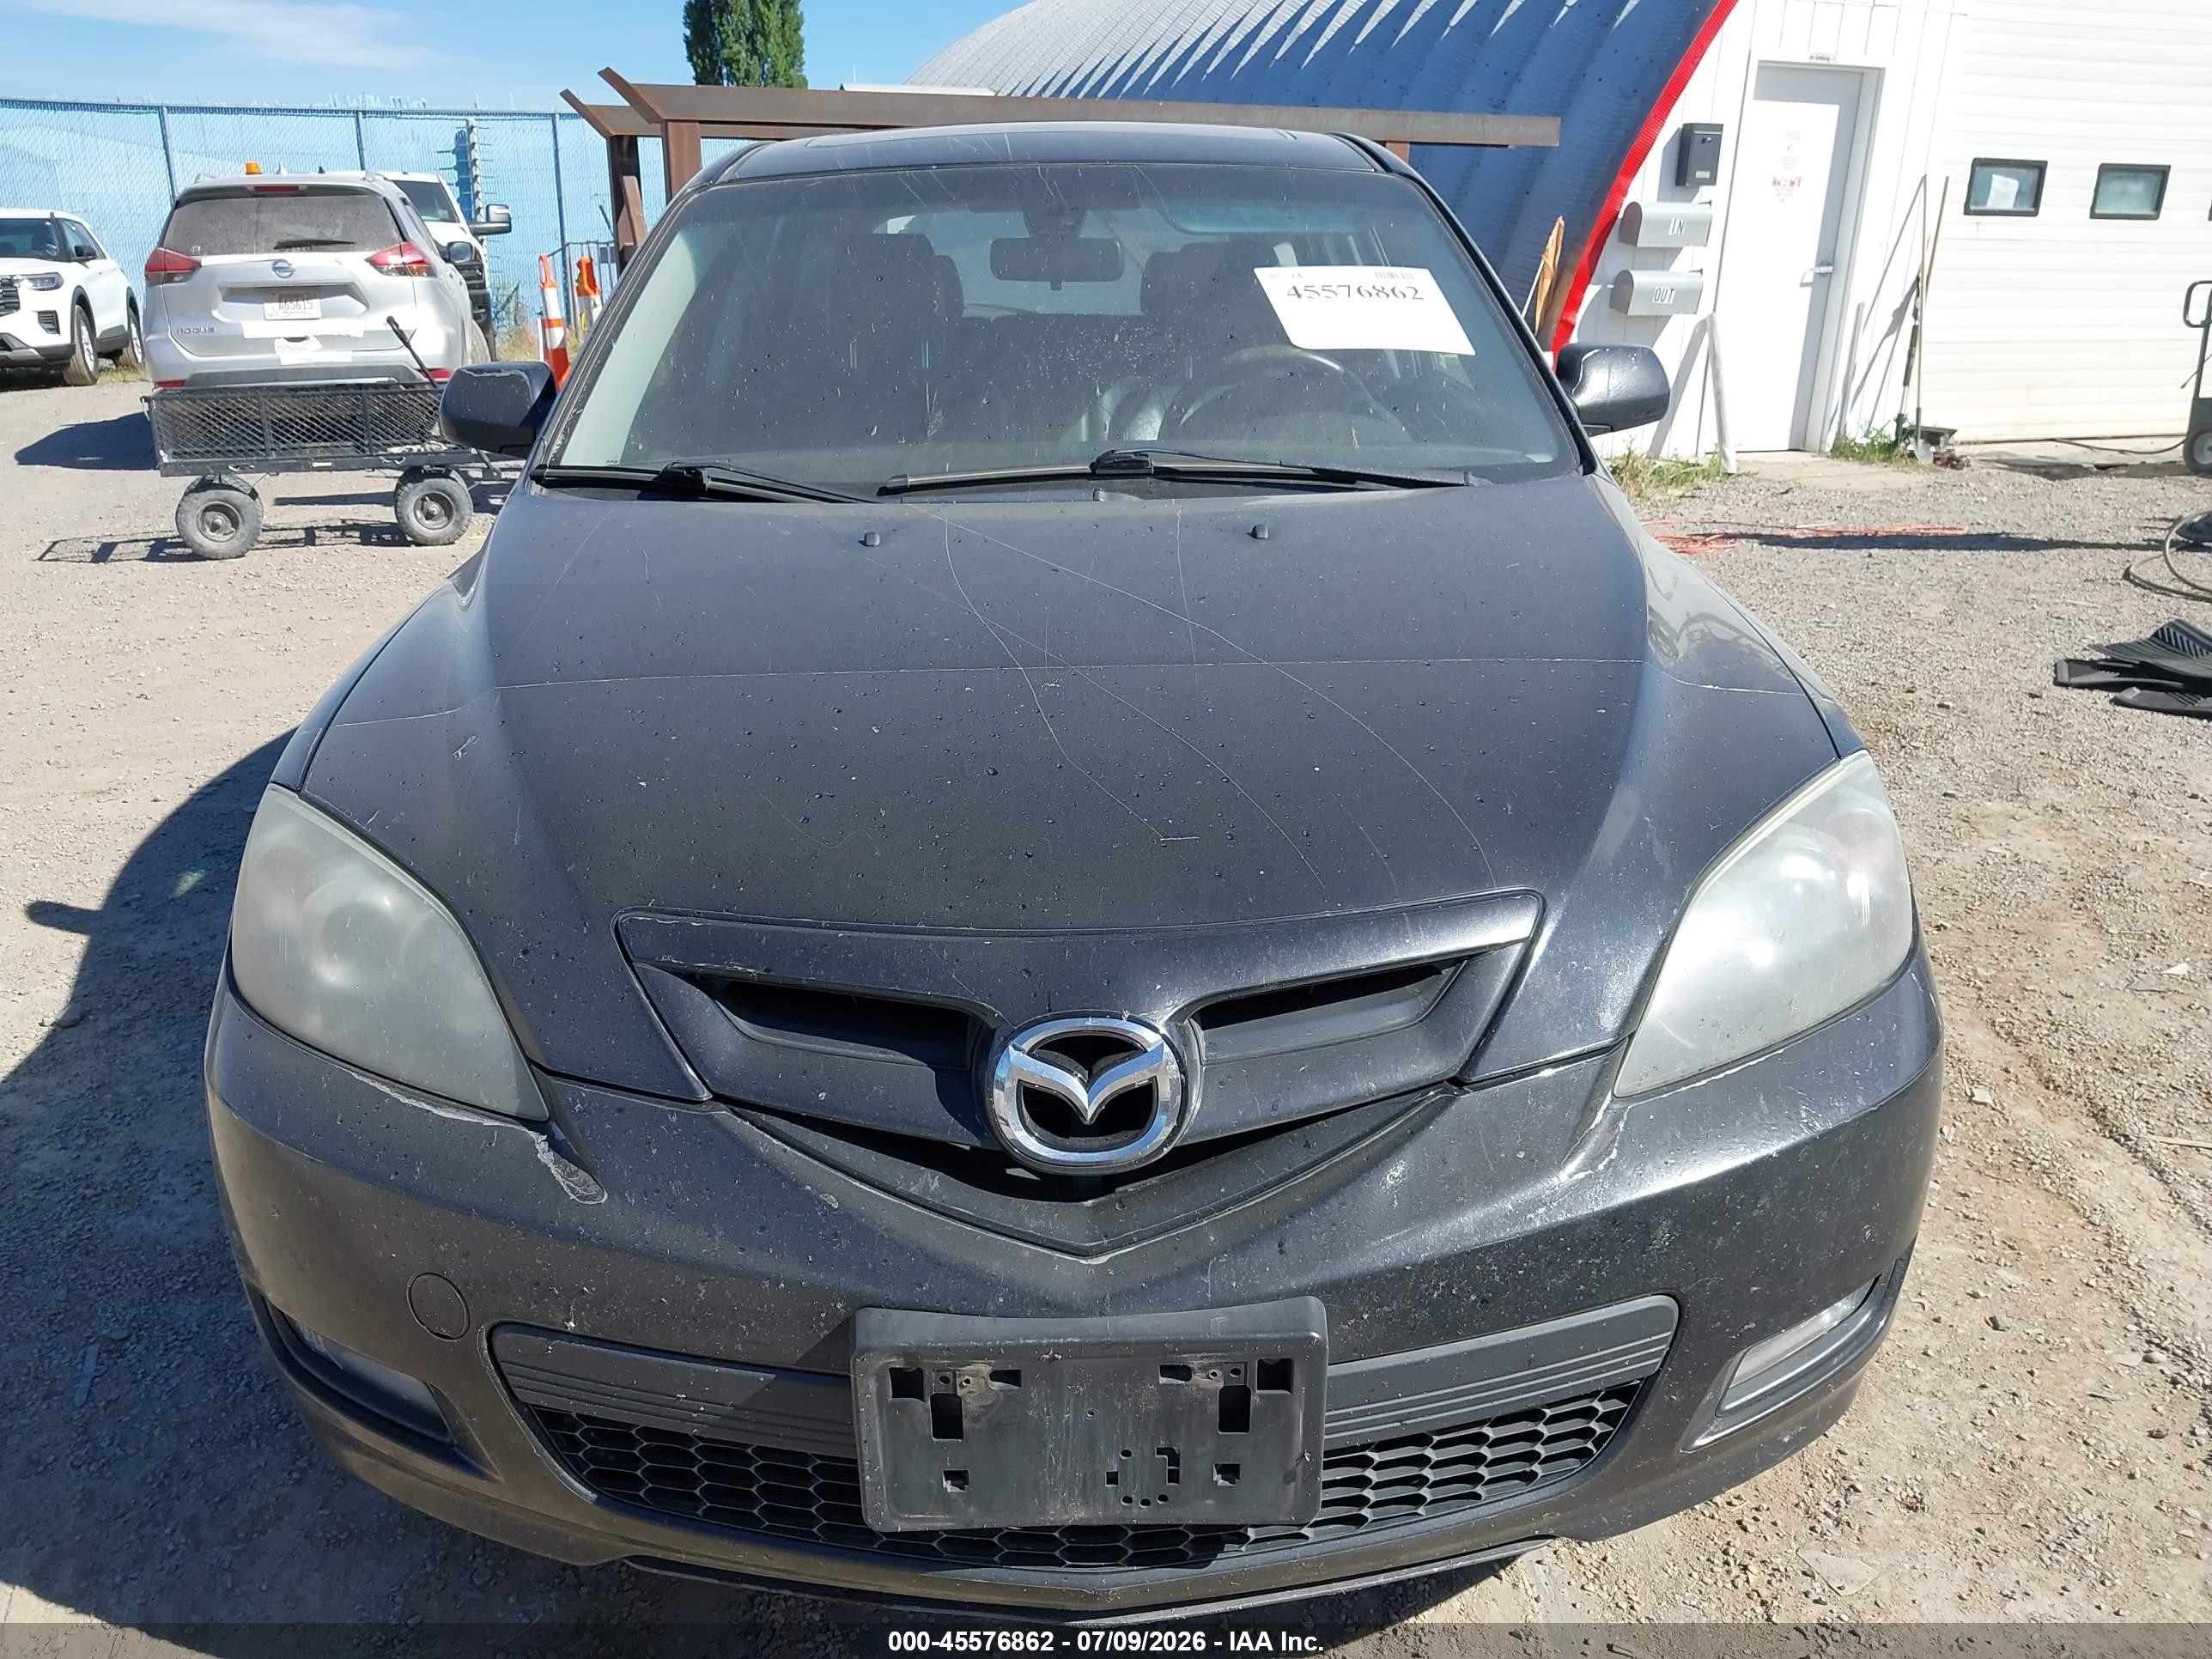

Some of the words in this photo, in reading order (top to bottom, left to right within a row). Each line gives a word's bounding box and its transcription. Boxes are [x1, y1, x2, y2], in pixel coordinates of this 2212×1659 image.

[1671, 218, 1685, 234] IN
[1286, 284, 1424, 301] 45576862
[1654, 288, 1675, 303] OUT
